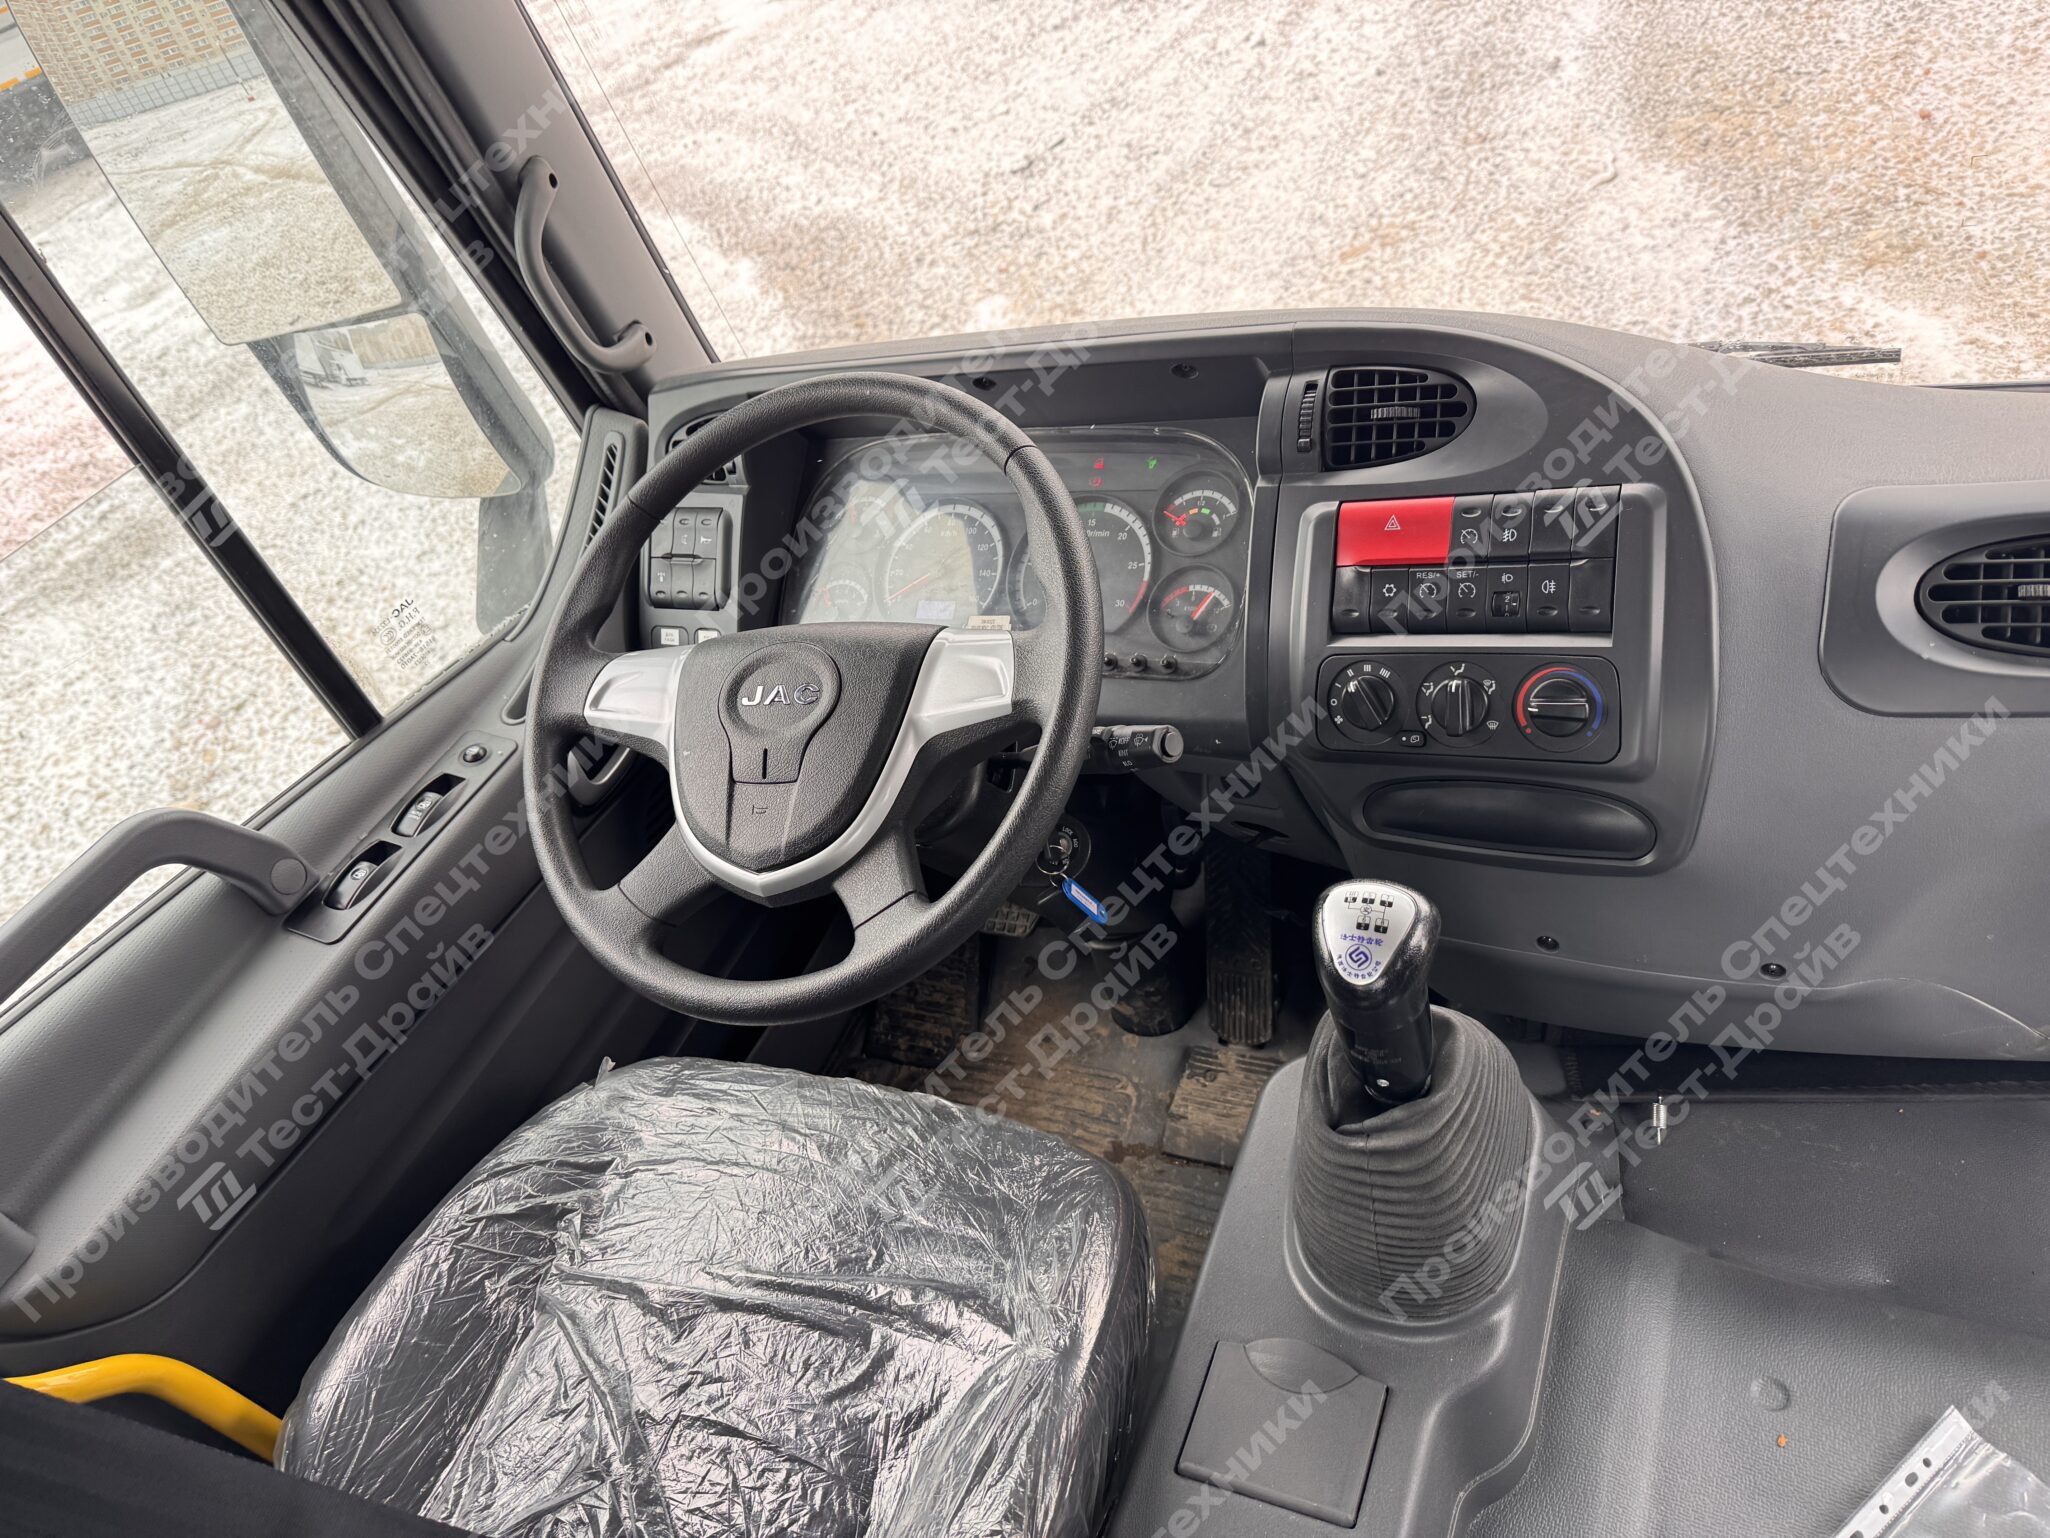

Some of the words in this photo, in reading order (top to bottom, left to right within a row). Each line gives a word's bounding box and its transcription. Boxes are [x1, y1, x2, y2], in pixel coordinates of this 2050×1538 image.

[1088, 518, 1096, 527] 15
[1117, 532, 1128, 541] 20
[977, 544, 989, 552] 120
[1127, 561, 1138, 570] 25
[979, 568, 991, 577] 140
[1456, 570, 1479, 579] SET/-
[1115, 599, 1125, 608] 30
[742, 683, 820, 706] JAC
